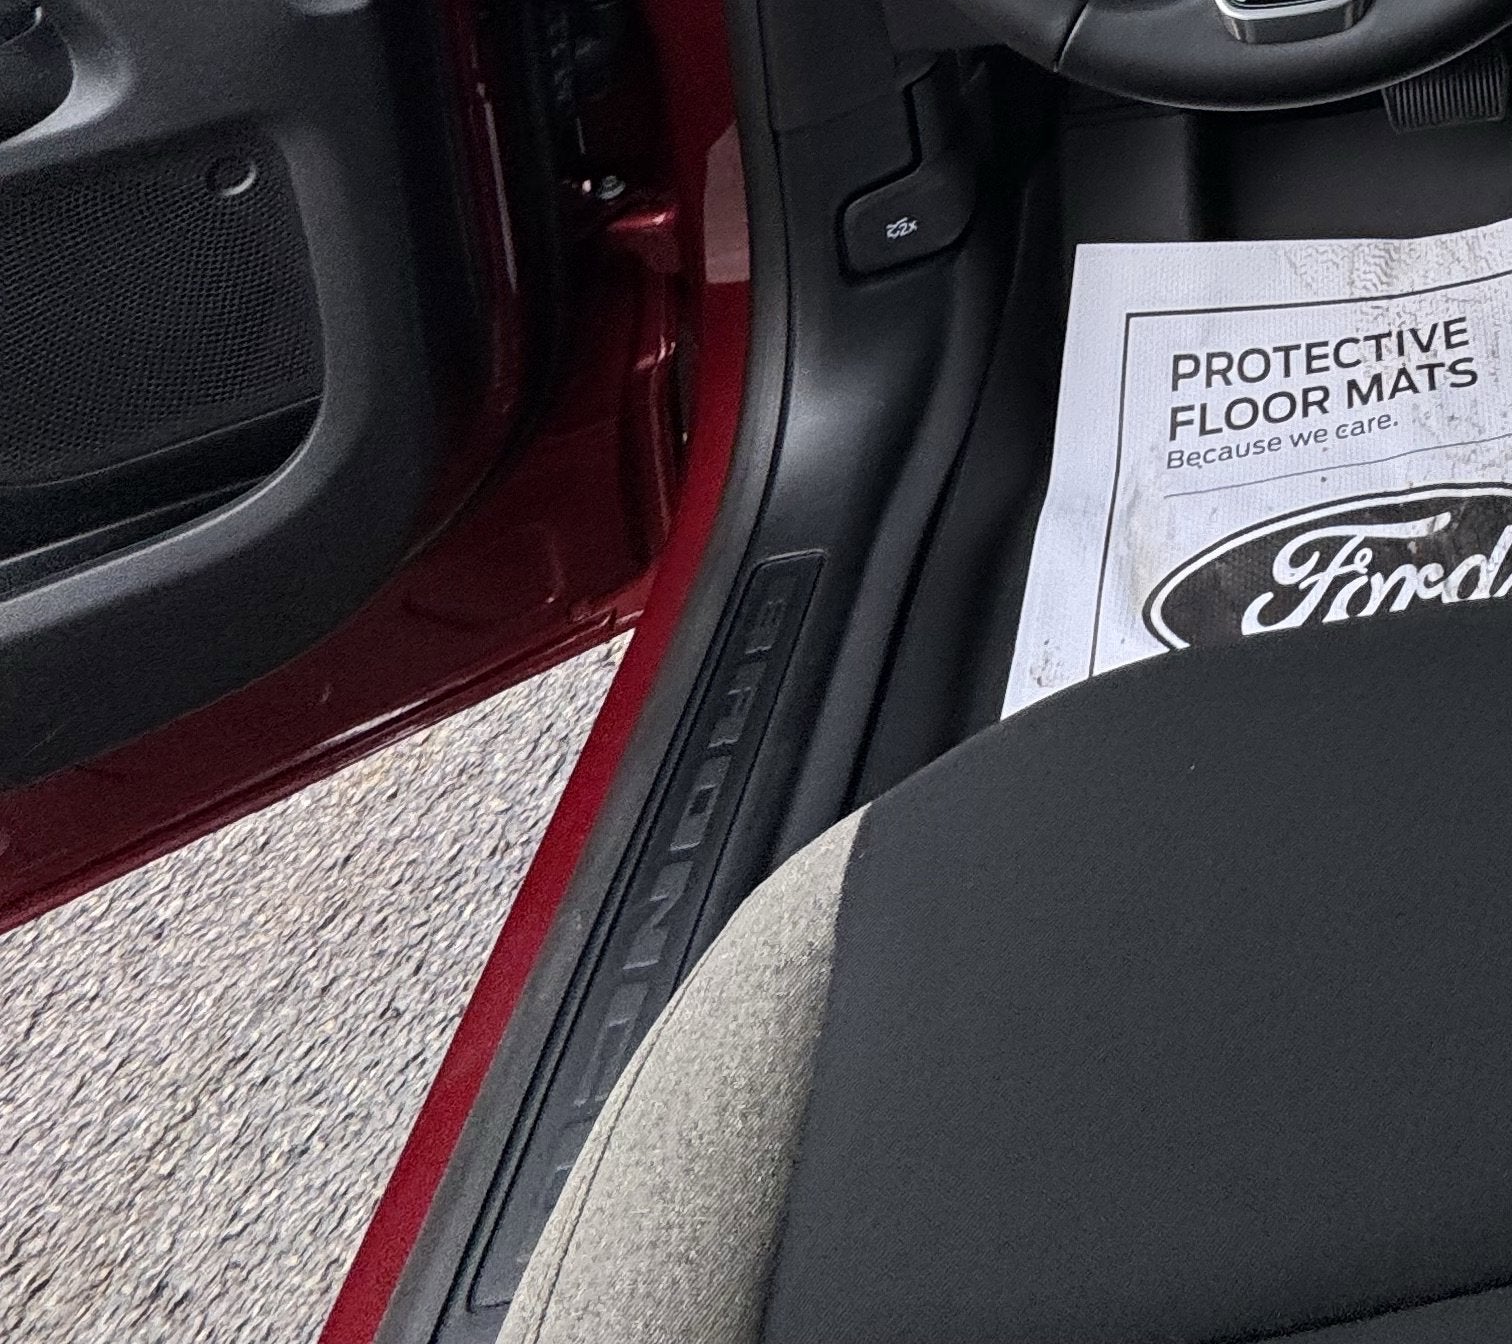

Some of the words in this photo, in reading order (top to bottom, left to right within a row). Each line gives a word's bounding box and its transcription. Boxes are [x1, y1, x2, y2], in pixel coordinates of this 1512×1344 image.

[1170, 316, 1470, 392] PROTECTIVE
[1168, 385, 1331, 442] FLOOR
[1346, 356, 1480, 410] MATS
[1166, 433, 1283, 470] Because
[1288, 427, 1329, 448] we
[1335, 414, 1399, 441] care.
